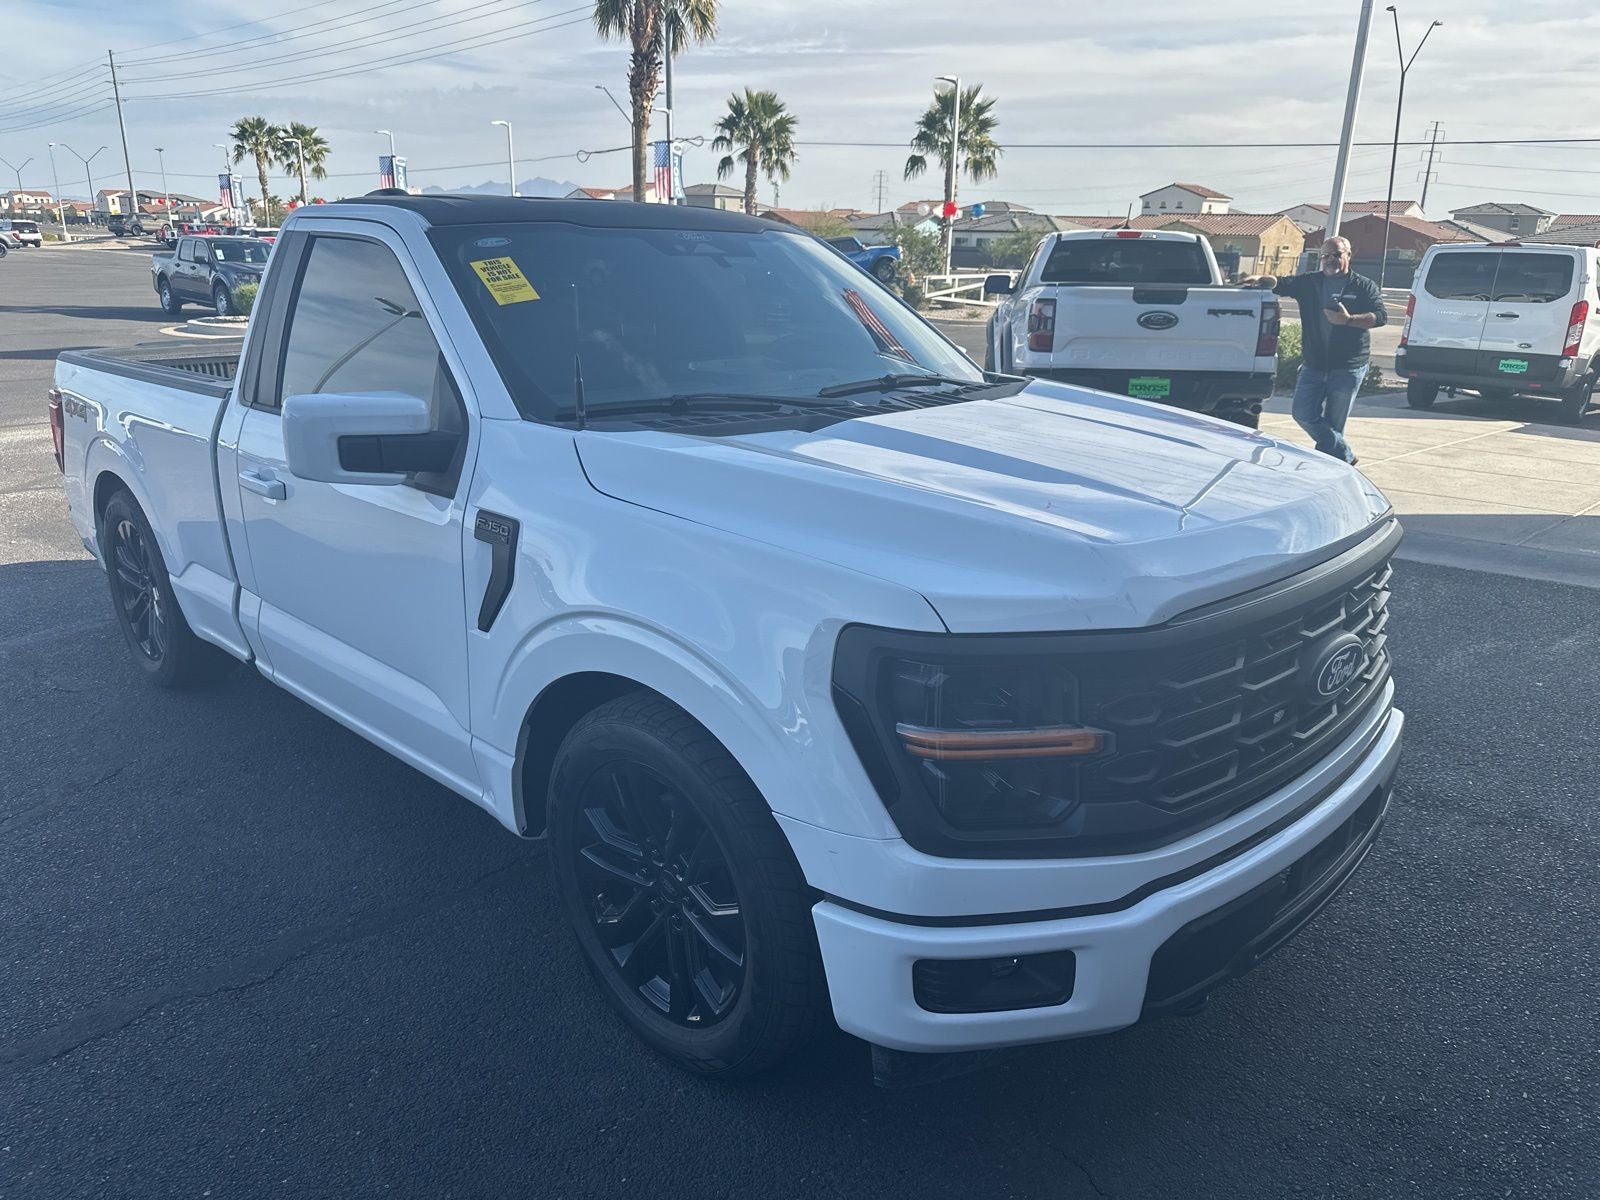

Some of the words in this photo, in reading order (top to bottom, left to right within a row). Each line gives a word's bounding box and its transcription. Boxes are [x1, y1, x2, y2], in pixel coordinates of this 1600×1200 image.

[480, 263, 512, 273] VEHICLE
[482, 259, 502, 267] THIS
[486, 276, 503, 284] FOR
[503, 272, 521, 281] SALE
[497, 268, 513, 277] NOT
[476, 518, 510, 537] F-150
[1327, 650, 1357, 691] Ford
